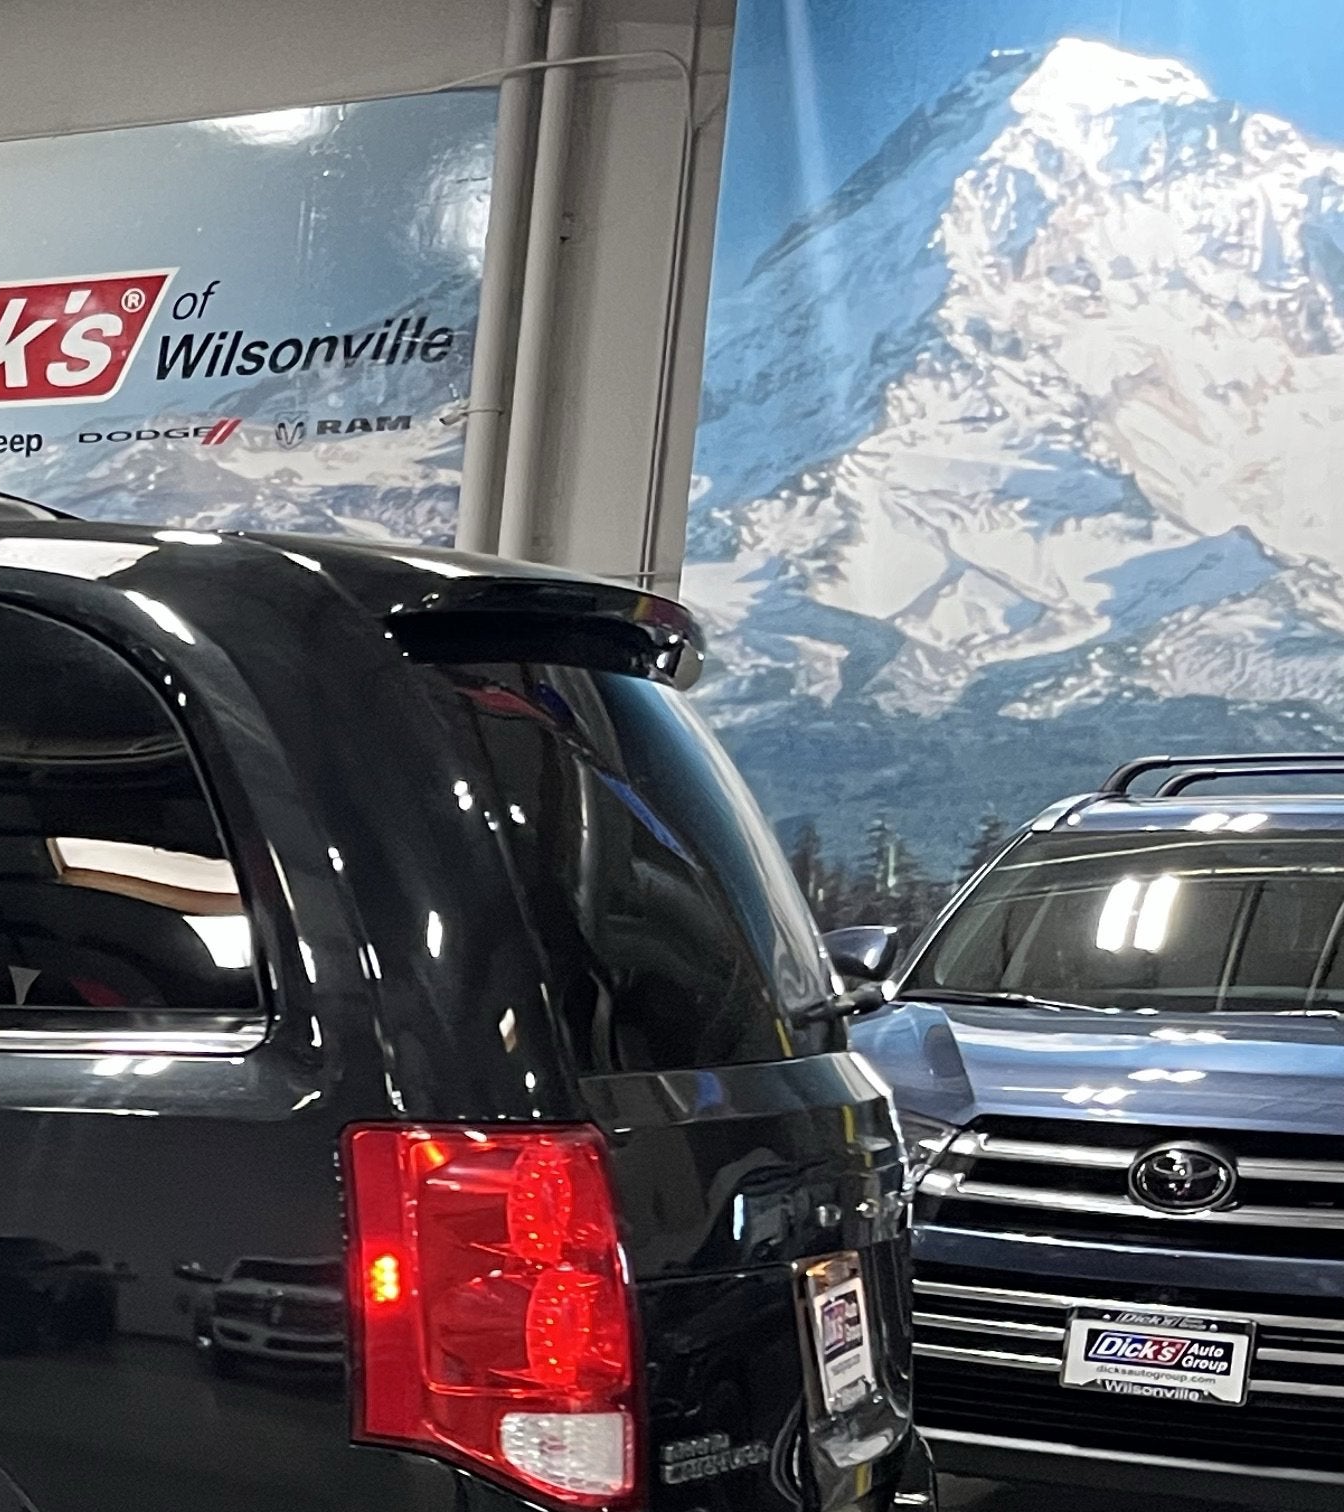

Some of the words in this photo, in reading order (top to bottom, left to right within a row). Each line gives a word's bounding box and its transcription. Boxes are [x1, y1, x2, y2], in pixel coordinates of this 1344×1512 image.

[172, 280, 221, 321] of
[156, 315, 455, 381] Wilsonville
[78, 426, 215, 444] DODGE
[316, 415, 412, 435] RAM
[1096, 1336, 1179, 1363] Dick's
[1186, 1342, 1224, 1357] Auto
[1096, 1364, 1216, 1384] dicksautogroup.com
[1181, 1355, 1228, 1374] Group
[1103, 1380, 1200, 1401] Wilsonville
